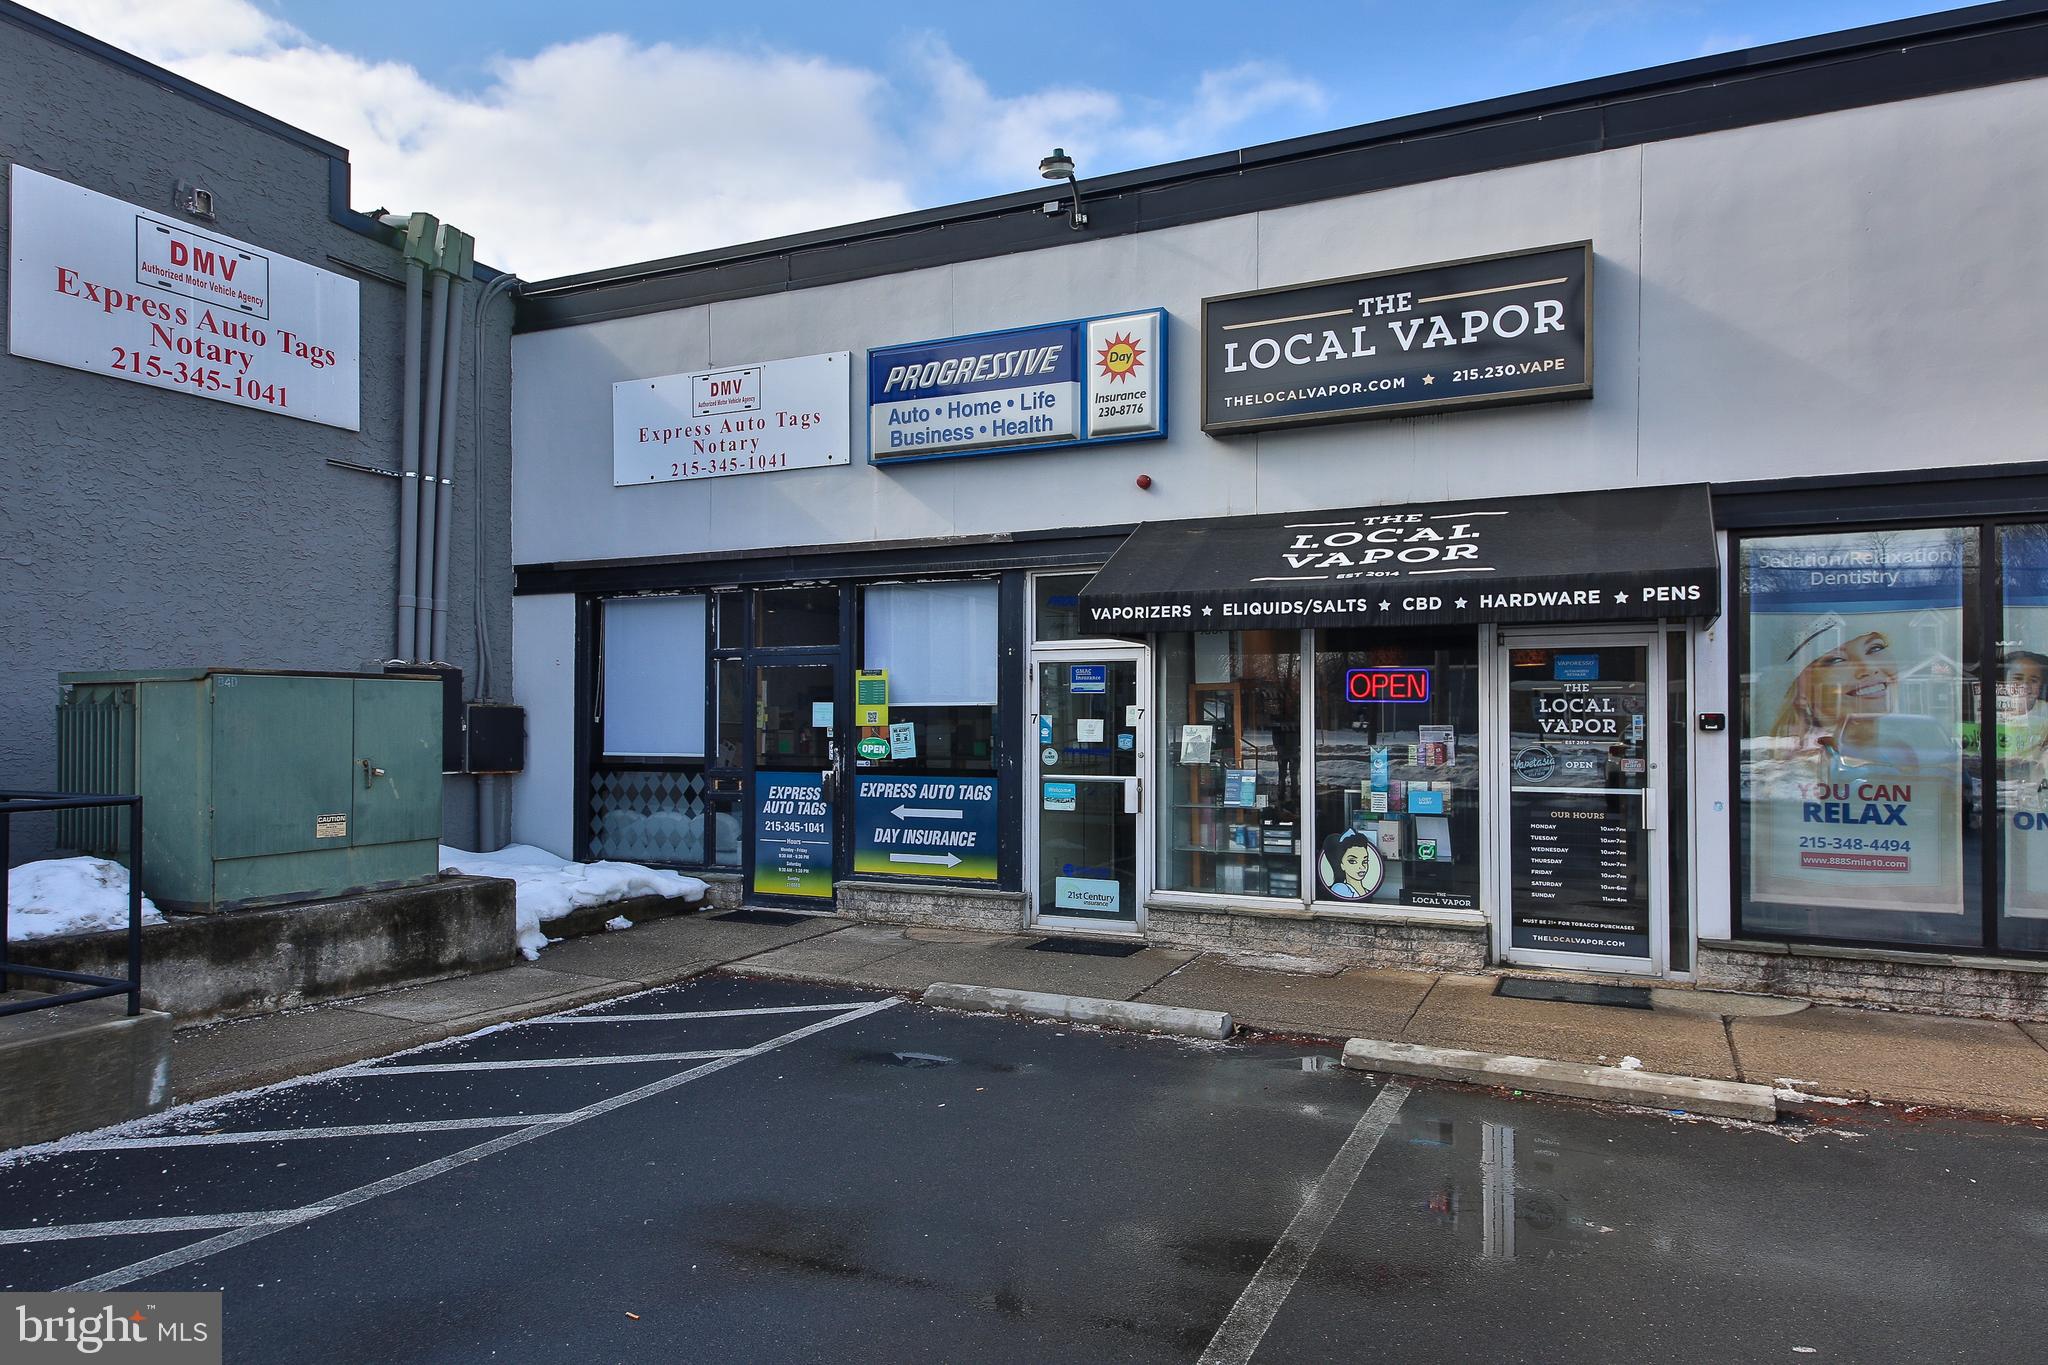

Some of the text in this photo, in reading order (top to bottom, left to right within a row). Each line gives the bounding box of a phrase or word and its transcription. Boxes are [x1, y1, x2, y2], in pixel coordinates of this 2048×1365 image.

[171, 240, 237, 281] DMV
[142, 261, 264, 308] Authorized Motor Vehicle Agency
[1358, 292, 1412, 317] THE
[55, 266, 336, 369] Express Auto Tags
[1224, 299, 1565, 373] LOCAL VAPOR
[150, 322, 253, 375] Notary
[1109, 351, 1132, 364] Day
[111, 346, 288, 408] 215-345-1041
[884, 345, 1063, 393] PROGRESSIVE
[711, 379, 742, 397] DMV
[1224, 358, 1565, 408] THELOCALVAPOR.COM 215.230.VAPE
[1095, 390, 1147, 404] Insurance
[888, 391, 1056, 426] Auto Home Life
[1098, 403, 1144, 417] 230-8776
[639, 410, 821, 444] Express Auto Tags
[890, 414, 1053, 447] Business Health
[692, 437, 760, 456] Notary
[672, 453, 787, 477] 215-345-1041
[1363, 514, 1423, 526] THE
[1290, 523, 1480, 549] LOCAL
[1282, 544, 1479, 569] VAPOR
[1759, 549, 1952, 569] Sedation/Relaxation
[1811, 570, 1899, 587] Dentistry
[1091, 585, 1701, 620] VAPORIZERS ELIQUIDS/SALTS CBD HARDWARE PENS
[1350, 673, 1426, 699] OPEN
[1564, 684, 1589, 692] THE
[1138, 709, 1145, 719] 7
[1540, 699, 1615, 713] LOCAL
[1030, 713, 1038, 724] 7
[1538, 719, 1617, 733] VAPOR
[861, 744, 886, 754] OPEN
[769, 786, 821, 800] EXPRESS
[860, 782, 993, 801] EXPRESS AUTO TAGS
[1797, 783, 1911, 801] YOU CAN
[763, 801, 827, 816] AUTO TAGS
[1573, 811, 1605, 819] HOURS
[1803, 802, 1907, 826] RELAX
[318, 815, 346, 823] CAUTION
[765, 820, 824, 833] 215-345-1041
[874, 828, 977, 847] DAY INSURANCE
[1799, 836, 1911, 852] 215-348-4494
[1803, 855, 1906, 868] www.888Smile10.com
[1067, 890, 1114, 903] 21st Century
[1442, 898, 1471, 906] VAPOR
[1600, 923, 1635, 931] PURCHASES
[1532, 934, 1625, 947] THELOCALVAPOR.COM
